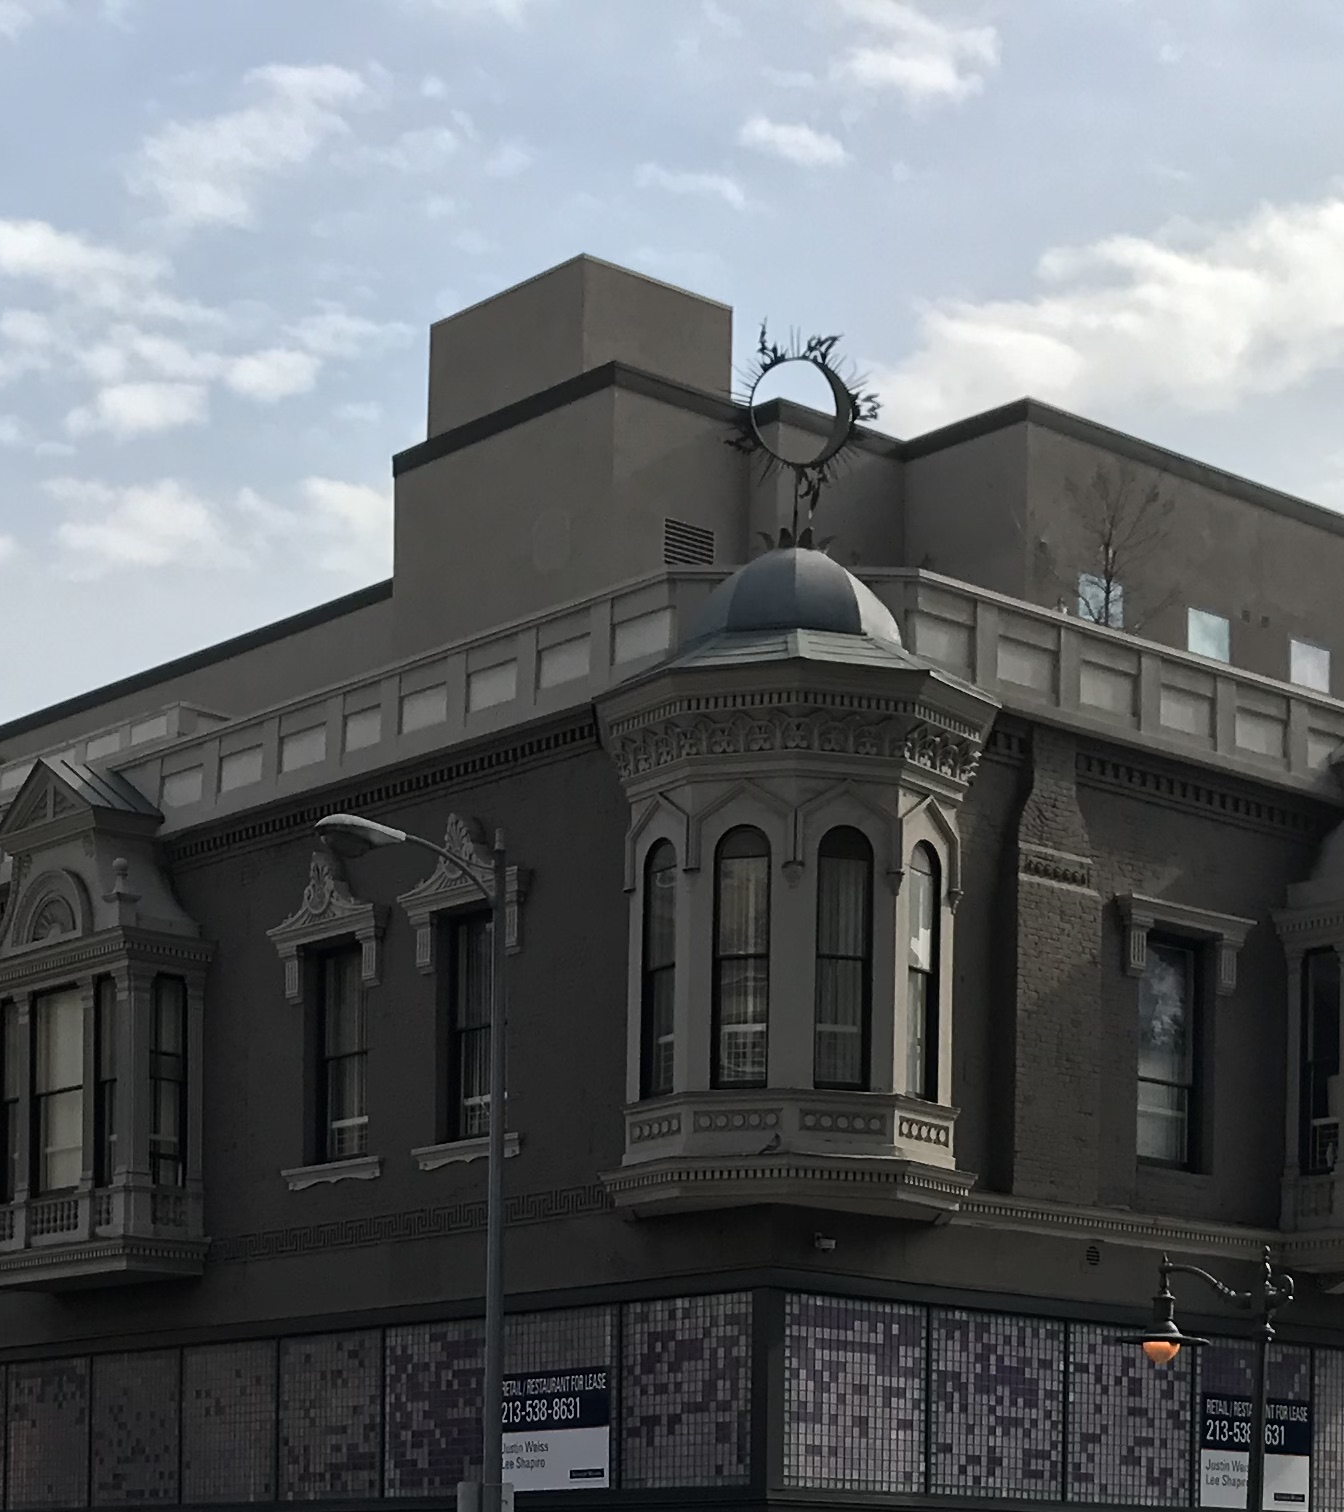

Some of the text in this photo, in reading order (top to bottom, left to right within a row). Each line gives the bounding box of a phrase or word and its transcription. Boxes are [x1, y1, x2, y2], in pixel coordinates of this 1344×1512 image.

[526, 1376, 570, 1395] RESTAURANT
[571, 1375, 584, 1391] FOR
[585, 1373, 606, 1390] LEASE
[502, 1397, 580, 1423] 213-538-8631
[1206, 1399, 1229, 1416] RETAIL
[1276, 1404, 1288, 1420] FOR
[1288, 1406, 1308, 1422] LEASE
[1206, 1419, 1284, 1446] 213-53631
[525, 1441, 548, 1453] Weiss
[516, 1457, 546, 1470] Shapiro
[1206, 1459, 1248, 1472] Justin Wei
[1206, 1474, 1248, 1488] Lee Shapir
